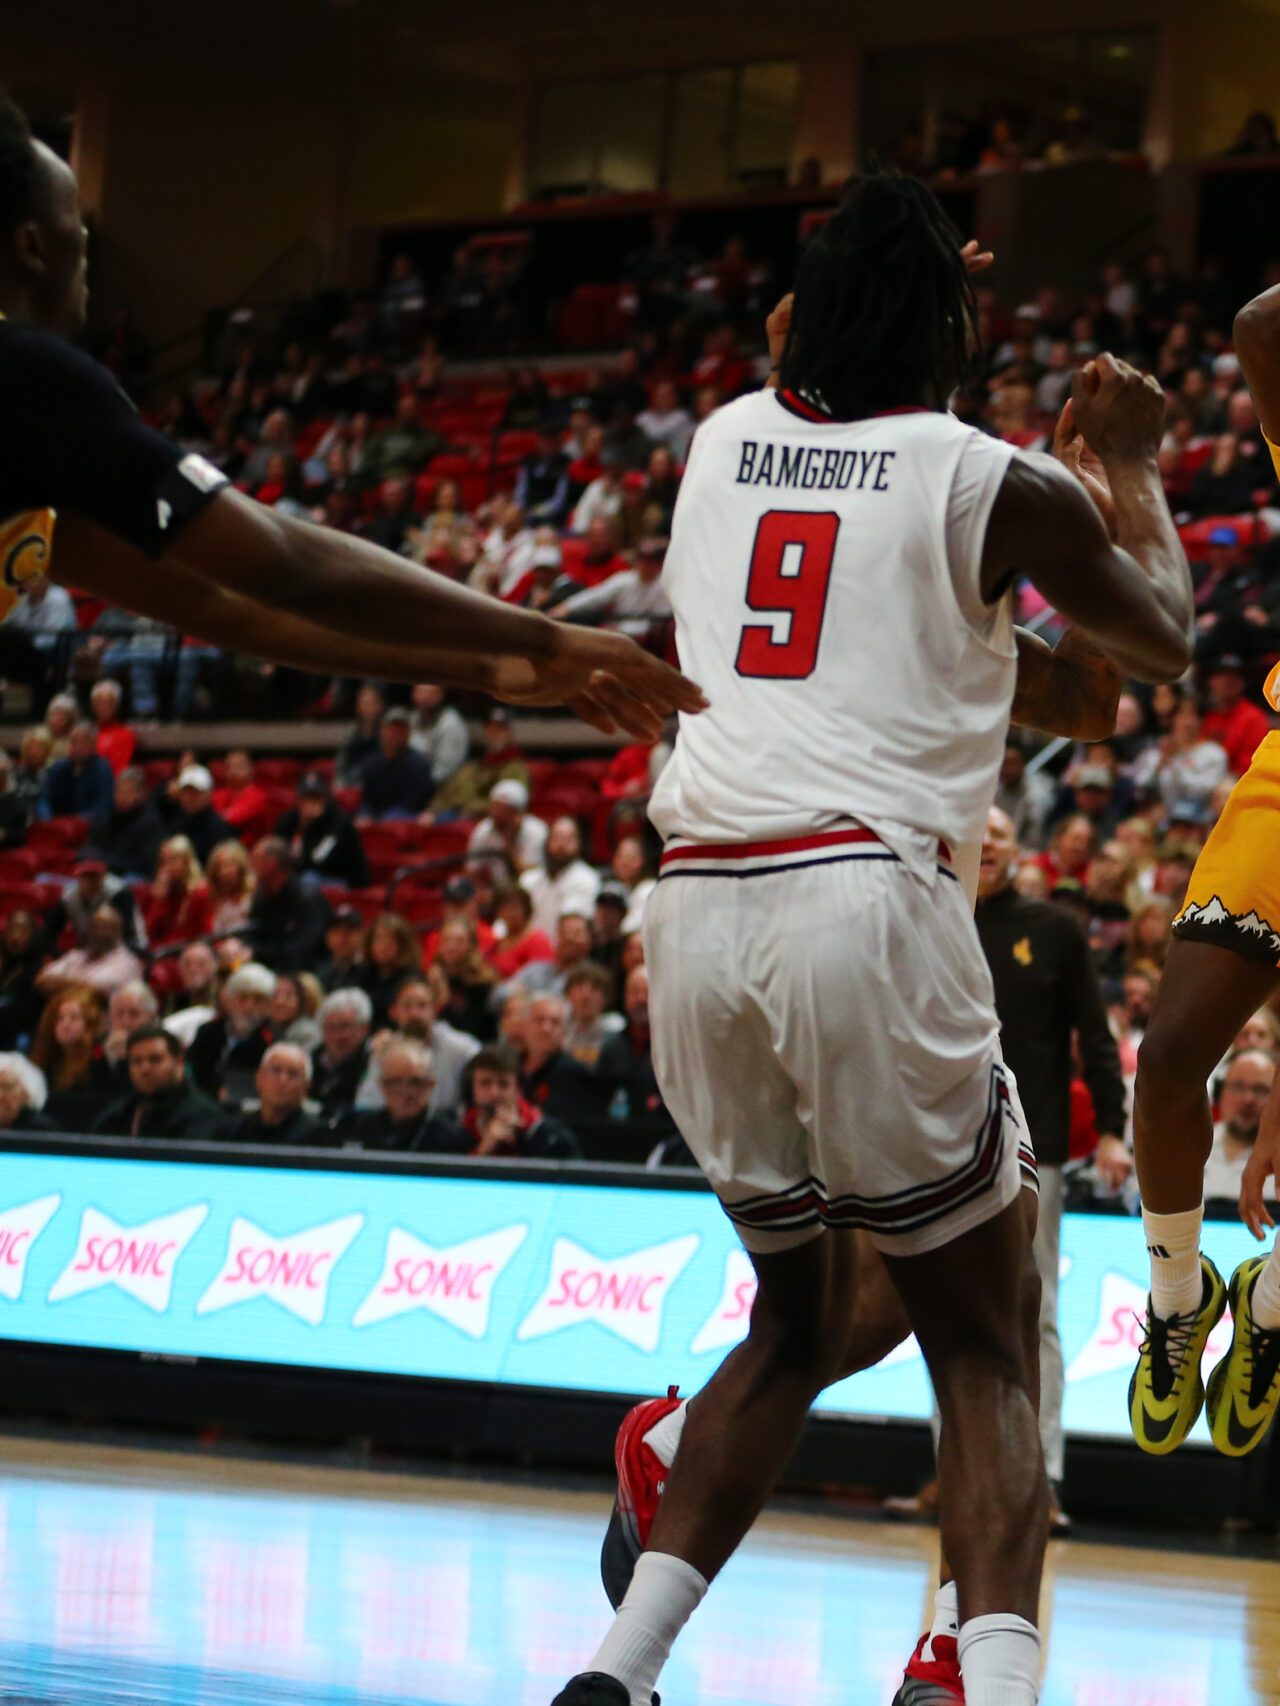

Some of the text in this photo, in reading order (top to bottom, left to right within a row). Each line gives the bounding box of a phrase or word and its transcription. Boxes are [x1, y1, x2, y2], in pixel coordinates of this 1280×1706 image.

[736, 441, 896, 491] BAMGBOYE
[734, 509, 840, 680] 9
[74, 1237, 177, 1277] SONIC
[223, 1247, 331, 1289] SONIC
[382, 1258, 494, 1301] SONIC
[547, 1268, 664, 1314] SONIC
